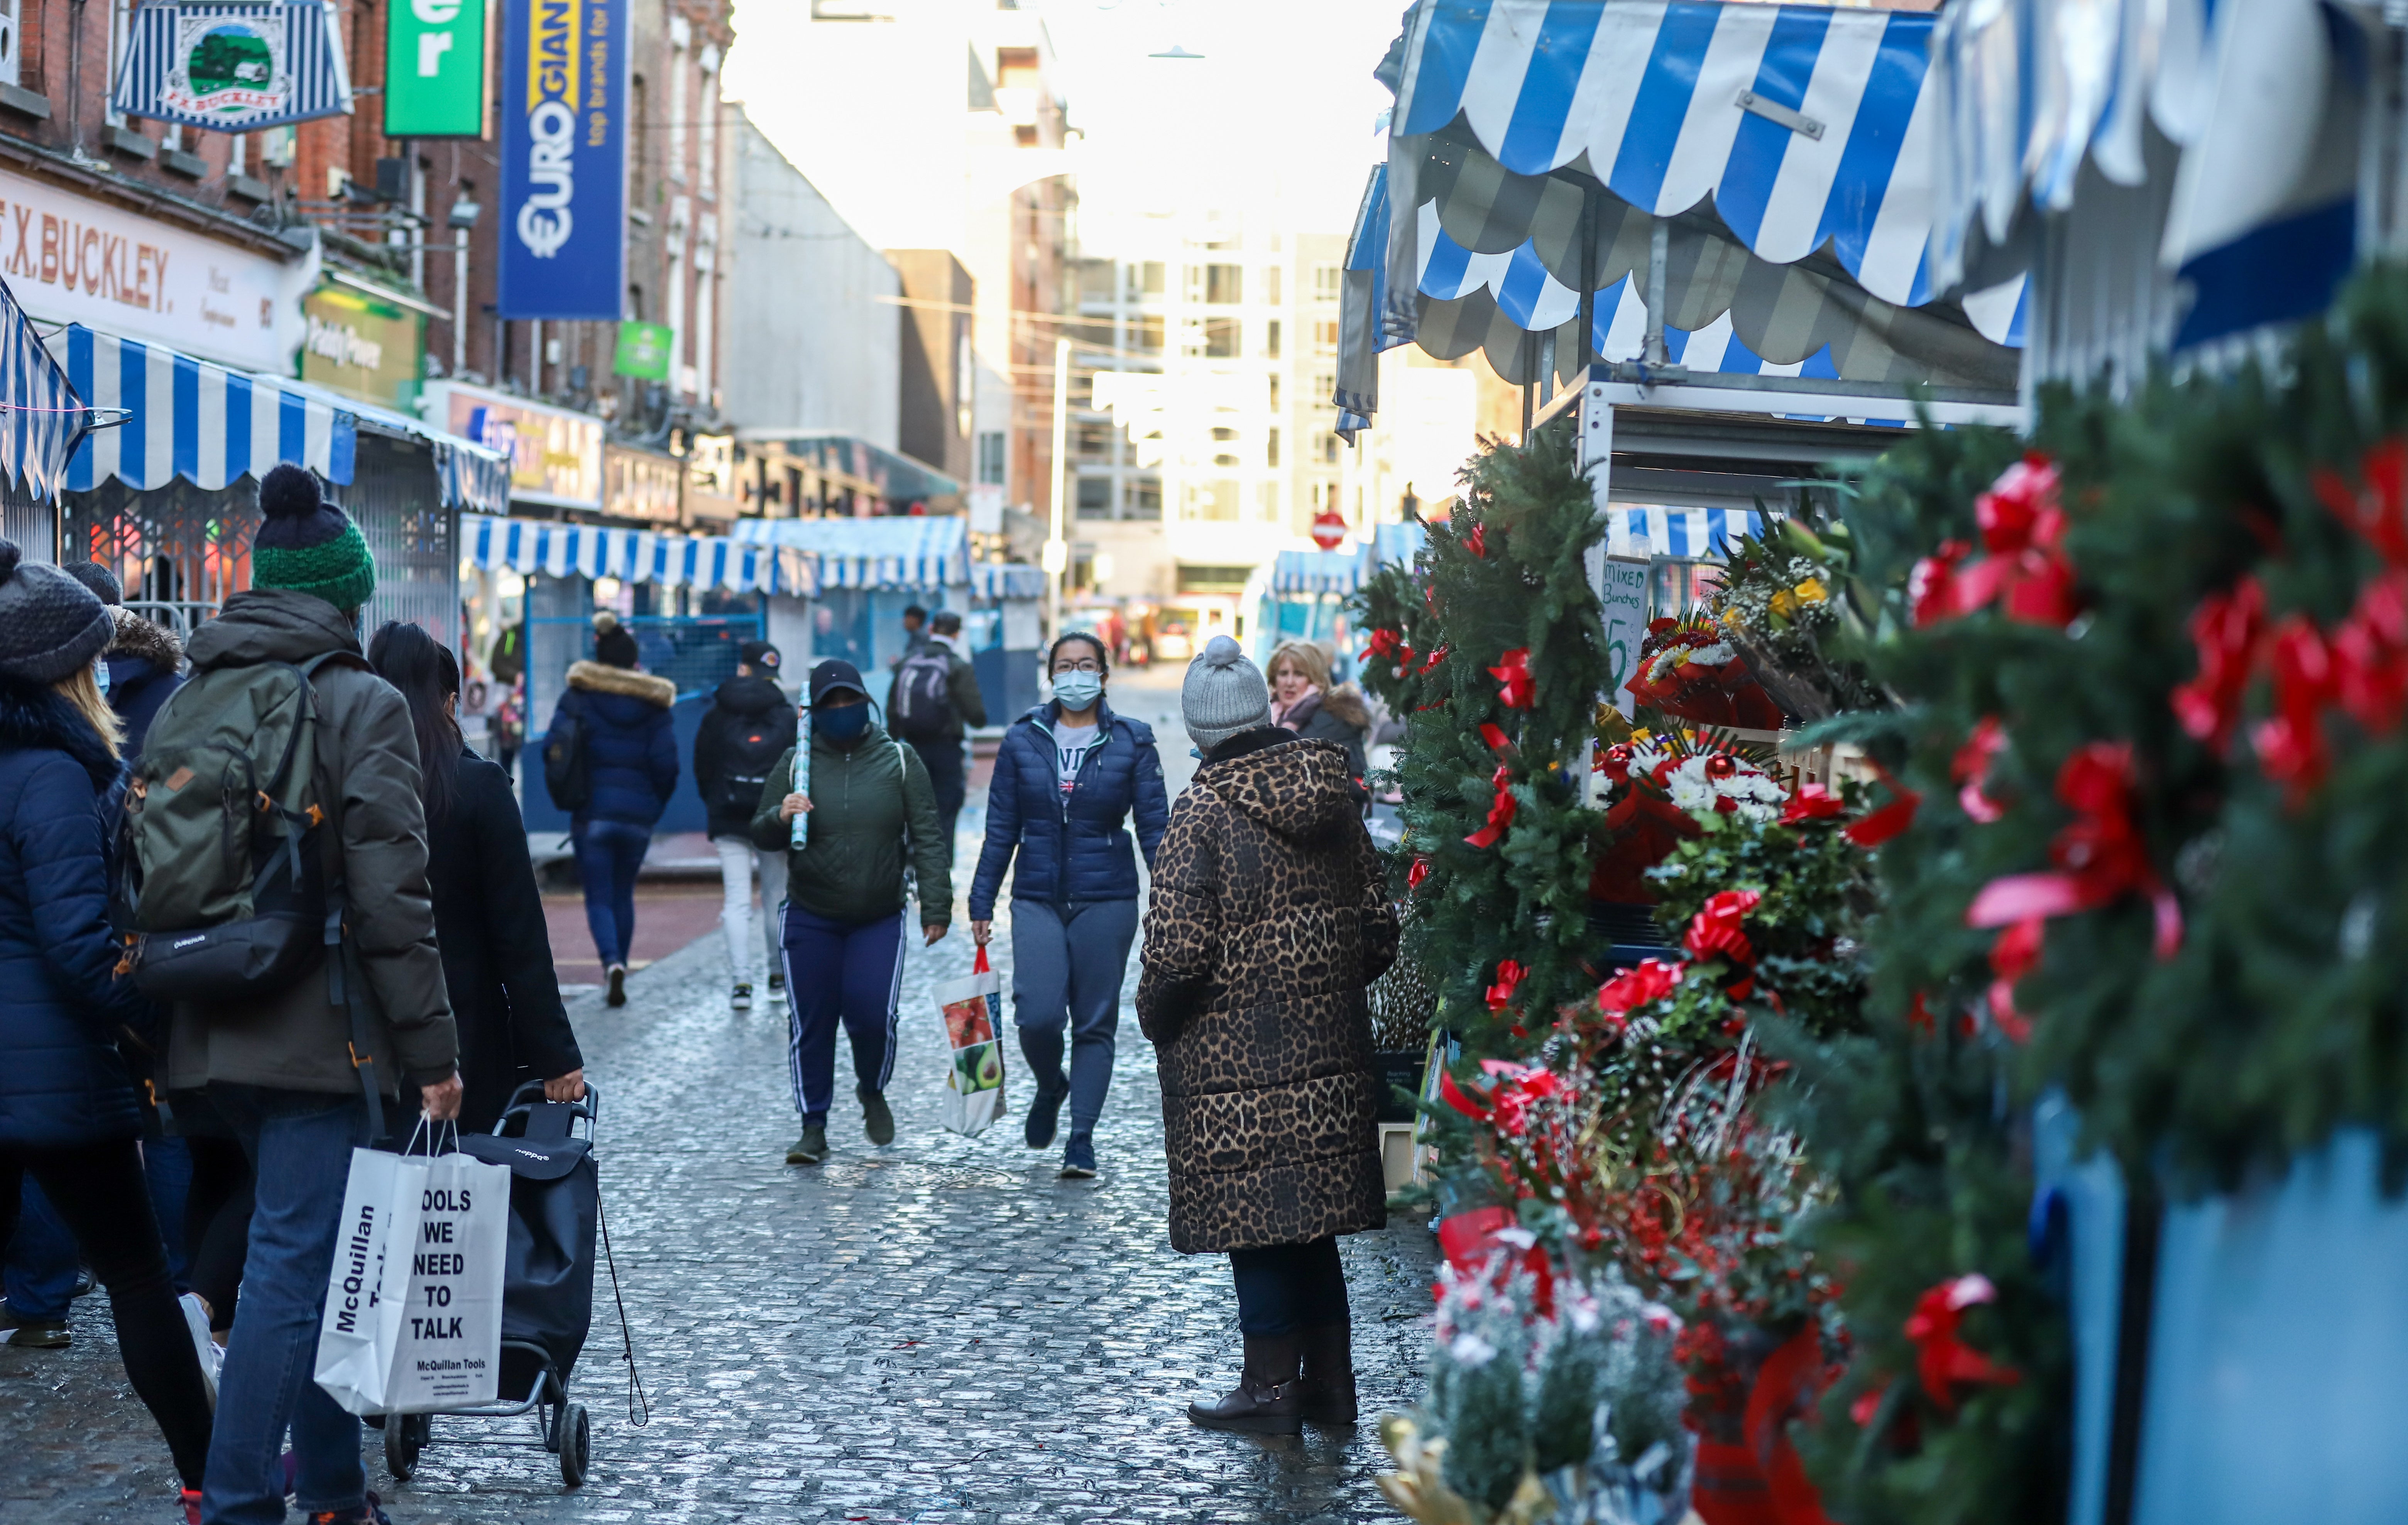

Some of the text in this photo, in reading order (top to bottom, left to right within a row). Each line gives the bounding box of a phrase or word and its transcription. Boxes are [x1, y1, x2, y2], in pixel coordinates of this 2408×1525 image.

[587, 8, 609, 147] top brands for
[1602, 583, 1640, 609] Bunches
[424, 1222, 453, 1243] WE
[336, 1205, 374, 1333] McQuillan
[414, 1254, 463, 1275] NEED
[424, 1285, 451, 1307] TO
[411, 1317, 463, 1340] TALK
[417, 1358, 485, 1371] McQuillan Tools
